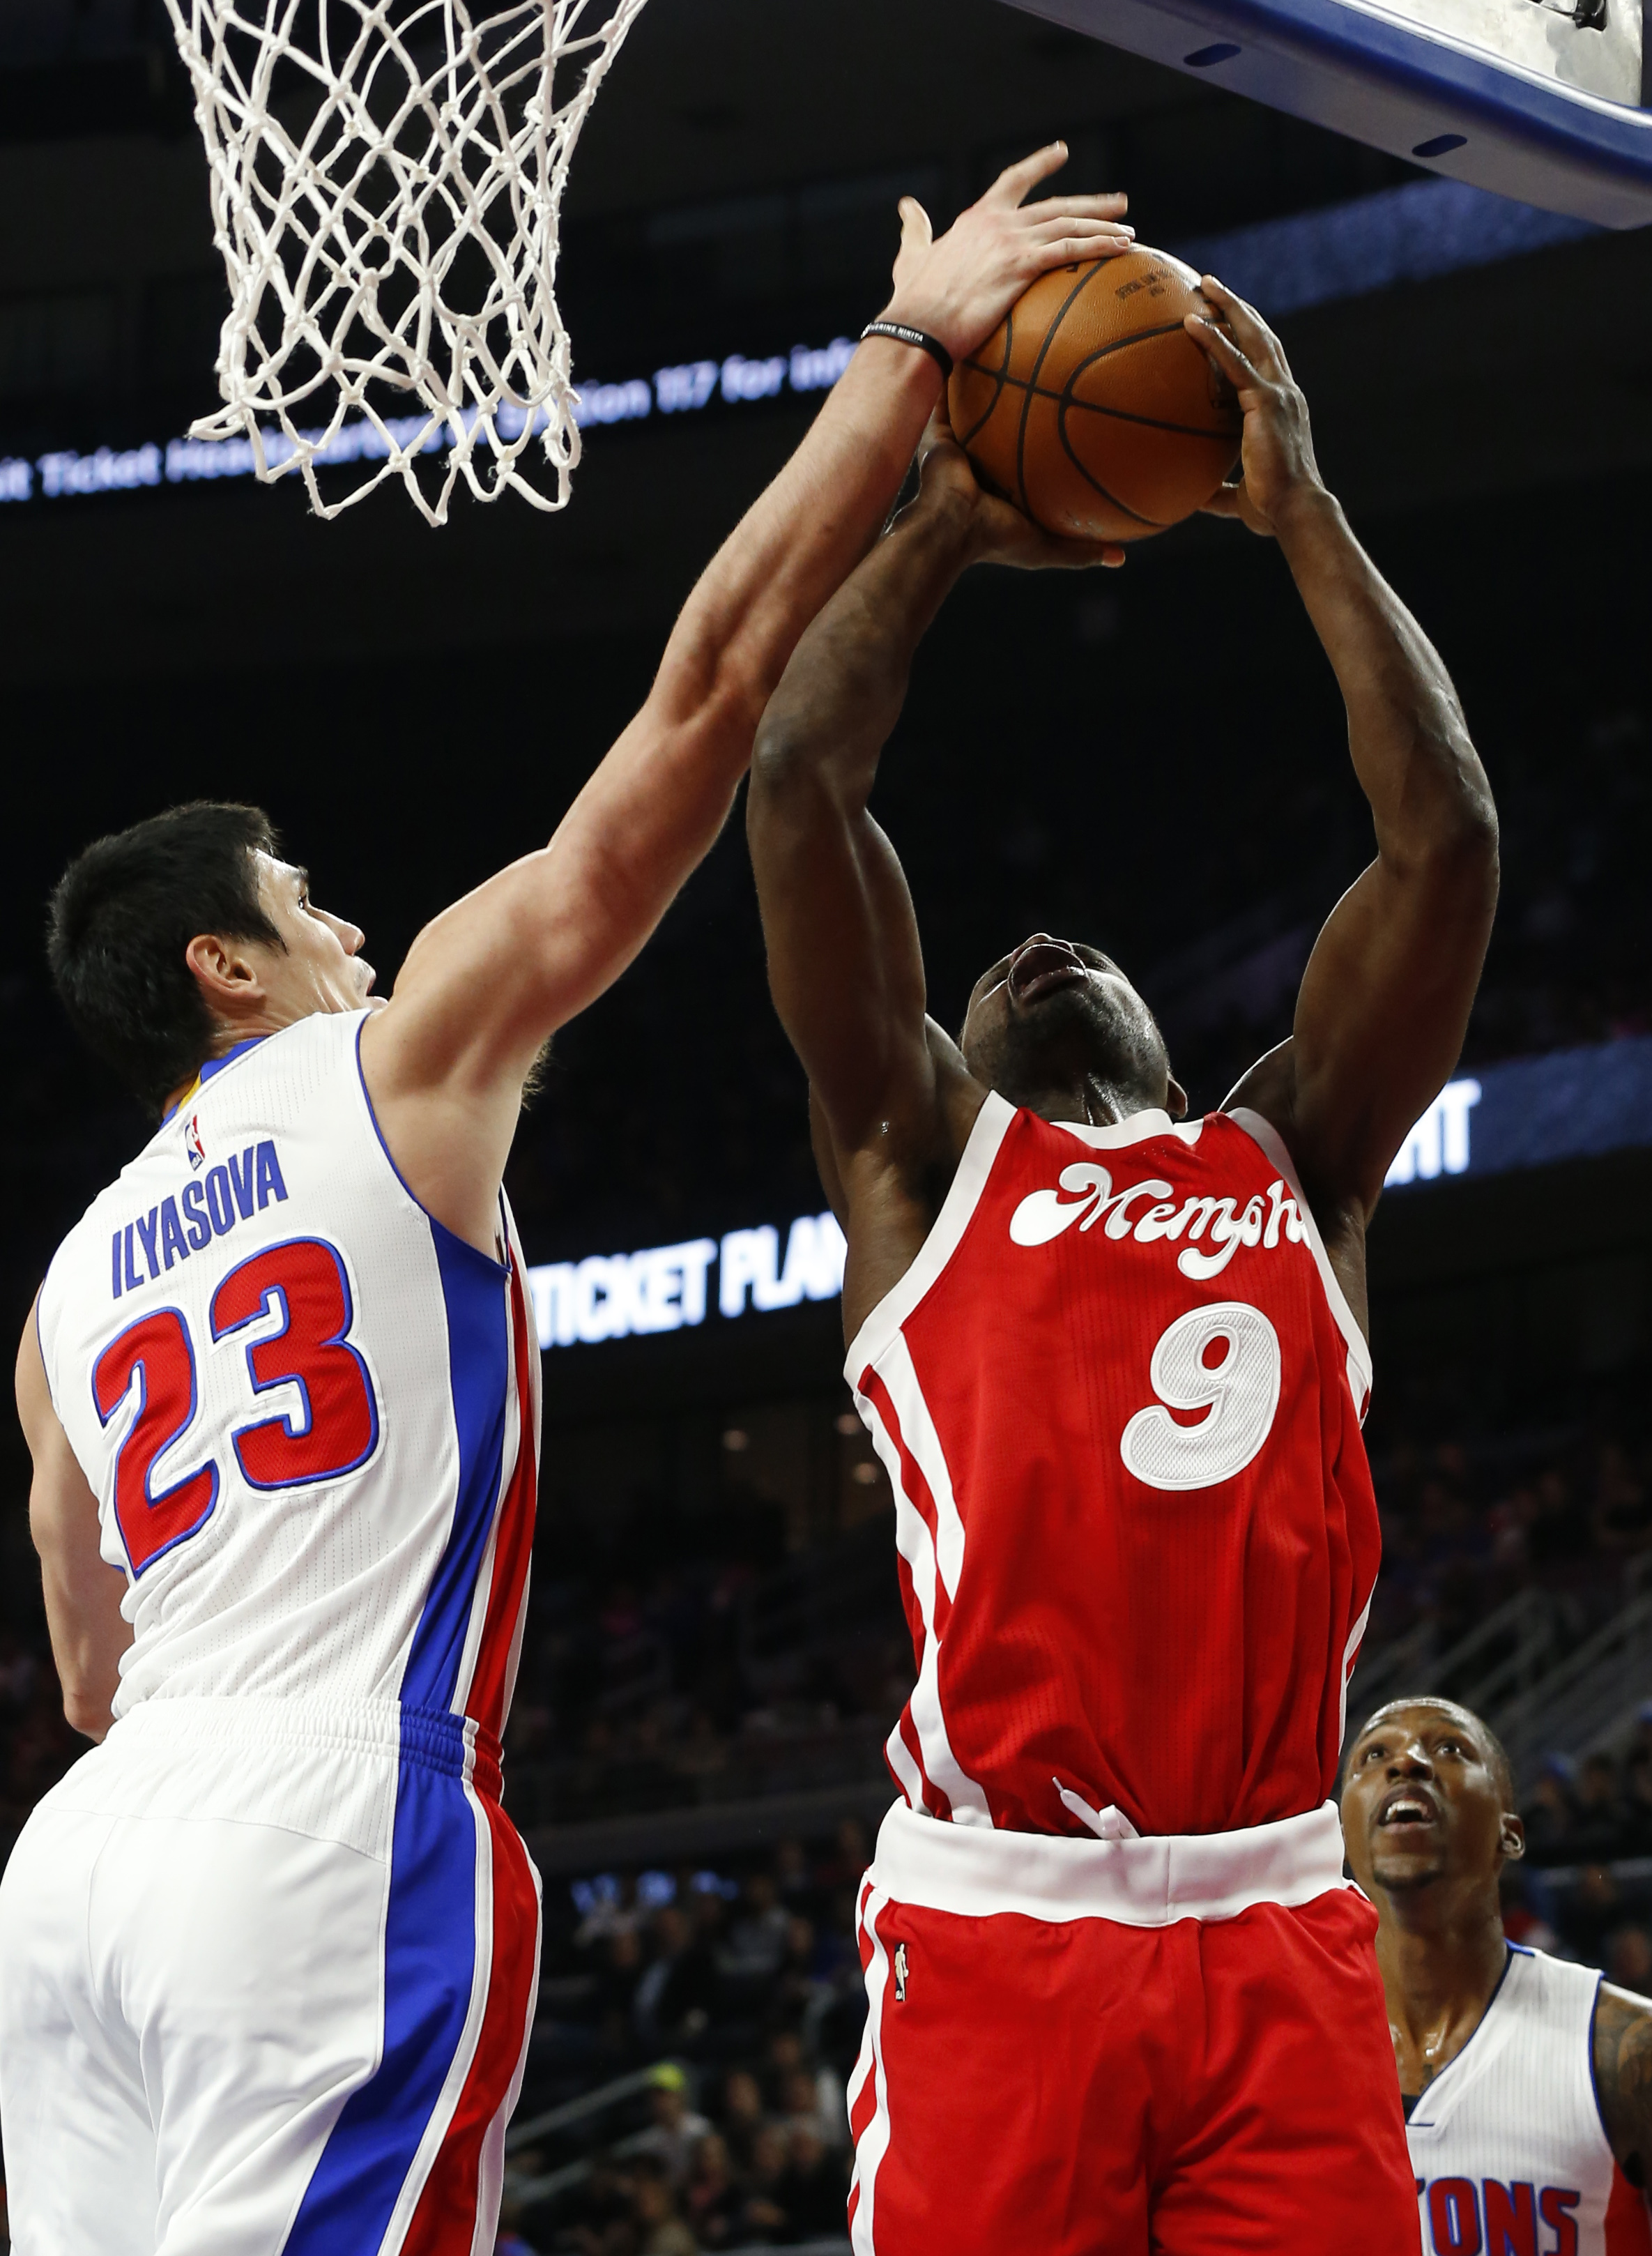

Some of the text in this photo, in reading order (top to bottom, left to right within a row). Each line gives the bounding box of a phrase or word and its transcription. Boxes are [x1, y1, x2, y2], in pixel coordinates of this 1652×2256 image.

[721, 353, 789, 404] for
[789, 336, 862, 392] inf
[112, 1139, 289, 1300] ILYASOVA
[527, 1237, 718, 1350] TICKET
[90, 1235, 381, 1581] 23
[1119, 1300, 1282, 1491] 9
[1416, 2176, 1581, 2256] ONS
